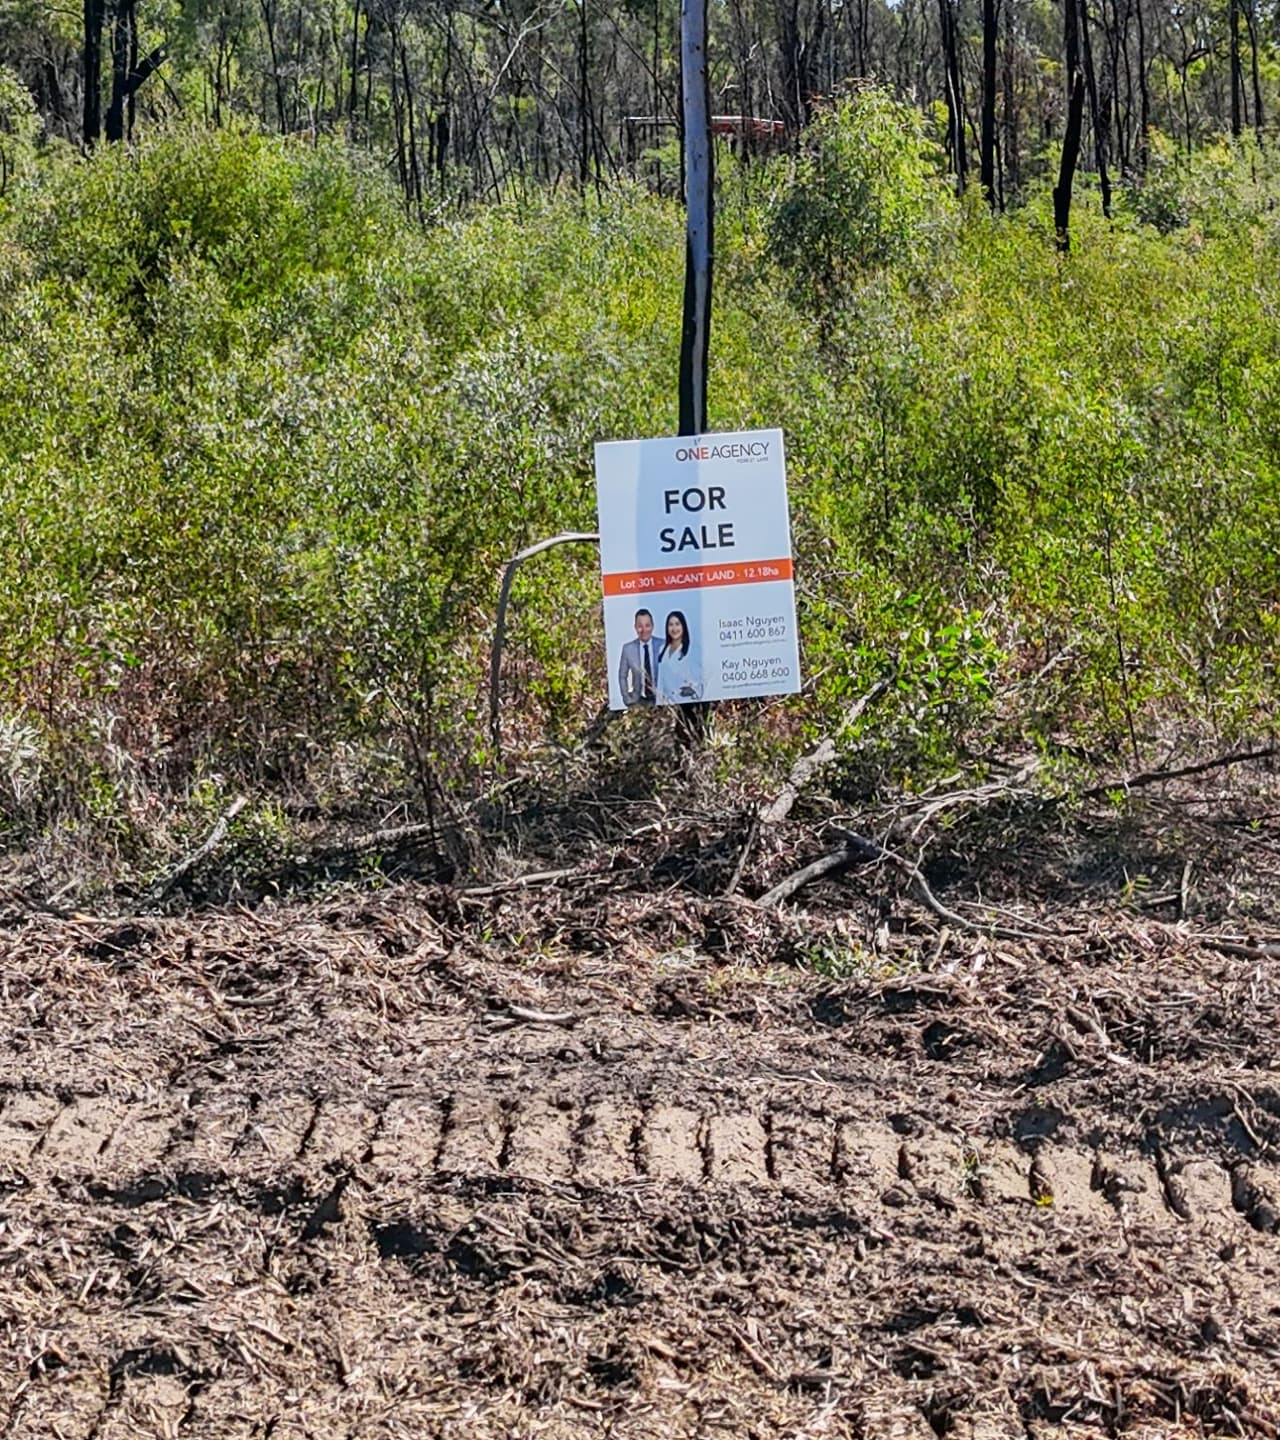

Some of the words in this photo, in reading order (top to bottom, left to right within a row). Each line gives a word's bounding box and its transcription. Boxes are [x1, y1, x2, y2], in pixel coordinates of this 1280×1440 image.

[664, 486, 727, 514] FOR
[659, 522, 736, 553] SALE
[620, 579, 636, 589] Lot
[638, 576, 655, 588] 301
[663, 572, 705, 585] VACANT
[706, 570, 736, 582] LAND
[745, 616, 785, 628] Nguyen
[720, 629, 743, 641] 0411
[747, 627, 766, 639] 600
[768, 625, 786, 637] 867
[721, 659, 740, 670] Kay
[742, 657, 782, 669] Nguyen
[722, 671, 748, 682] 0400
[771, 666, 790, 678] 600
